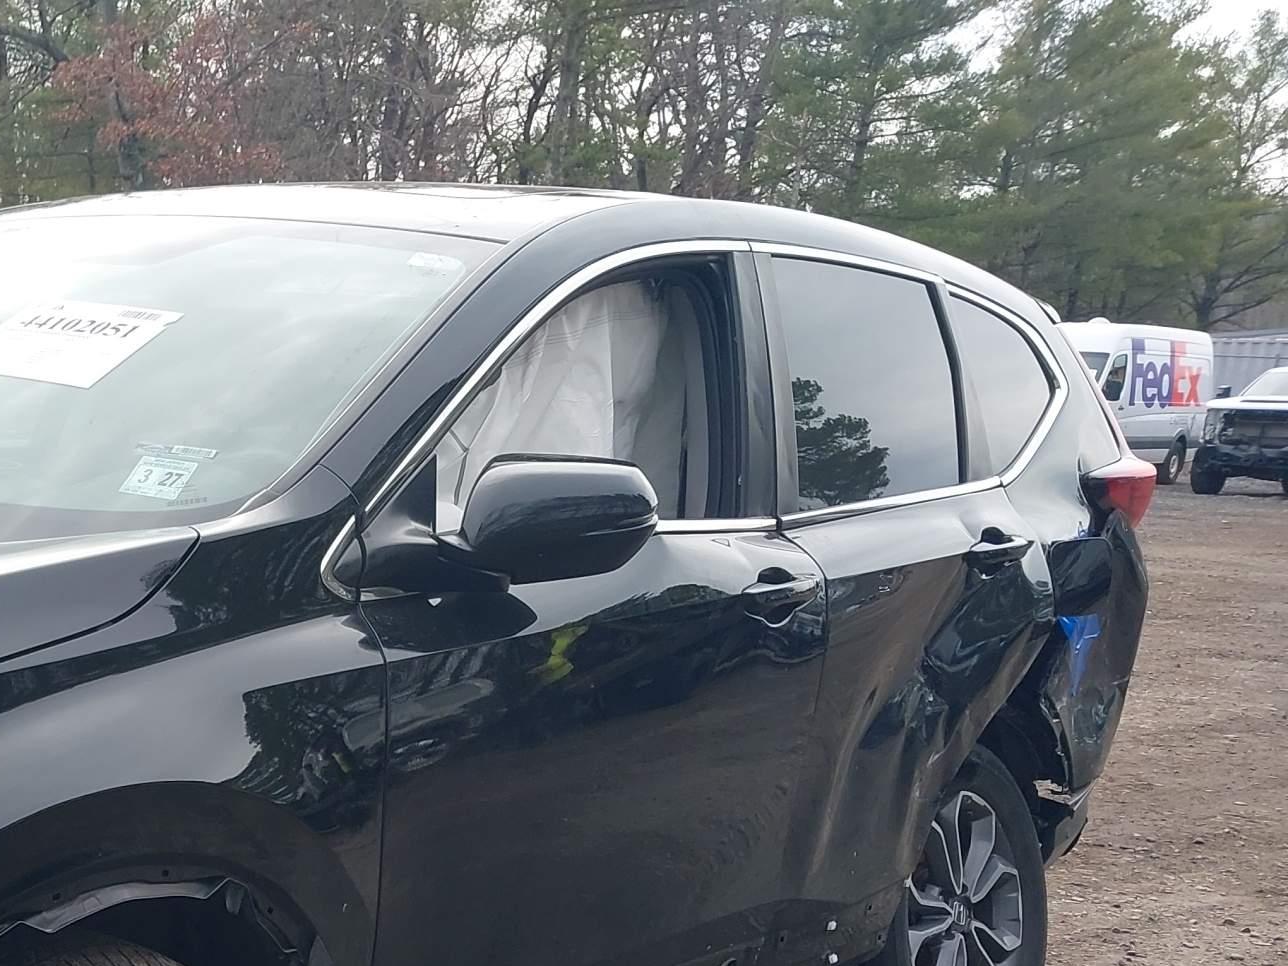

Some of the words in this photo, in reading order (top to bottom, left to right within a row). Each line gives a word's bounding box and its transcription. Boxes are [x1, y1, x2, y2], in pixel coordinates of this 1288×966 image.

[21, 315, 140, 338] 44102051
[1129, 338, 1203, 408] FedEx
[138, 469, 154, 483] 3
